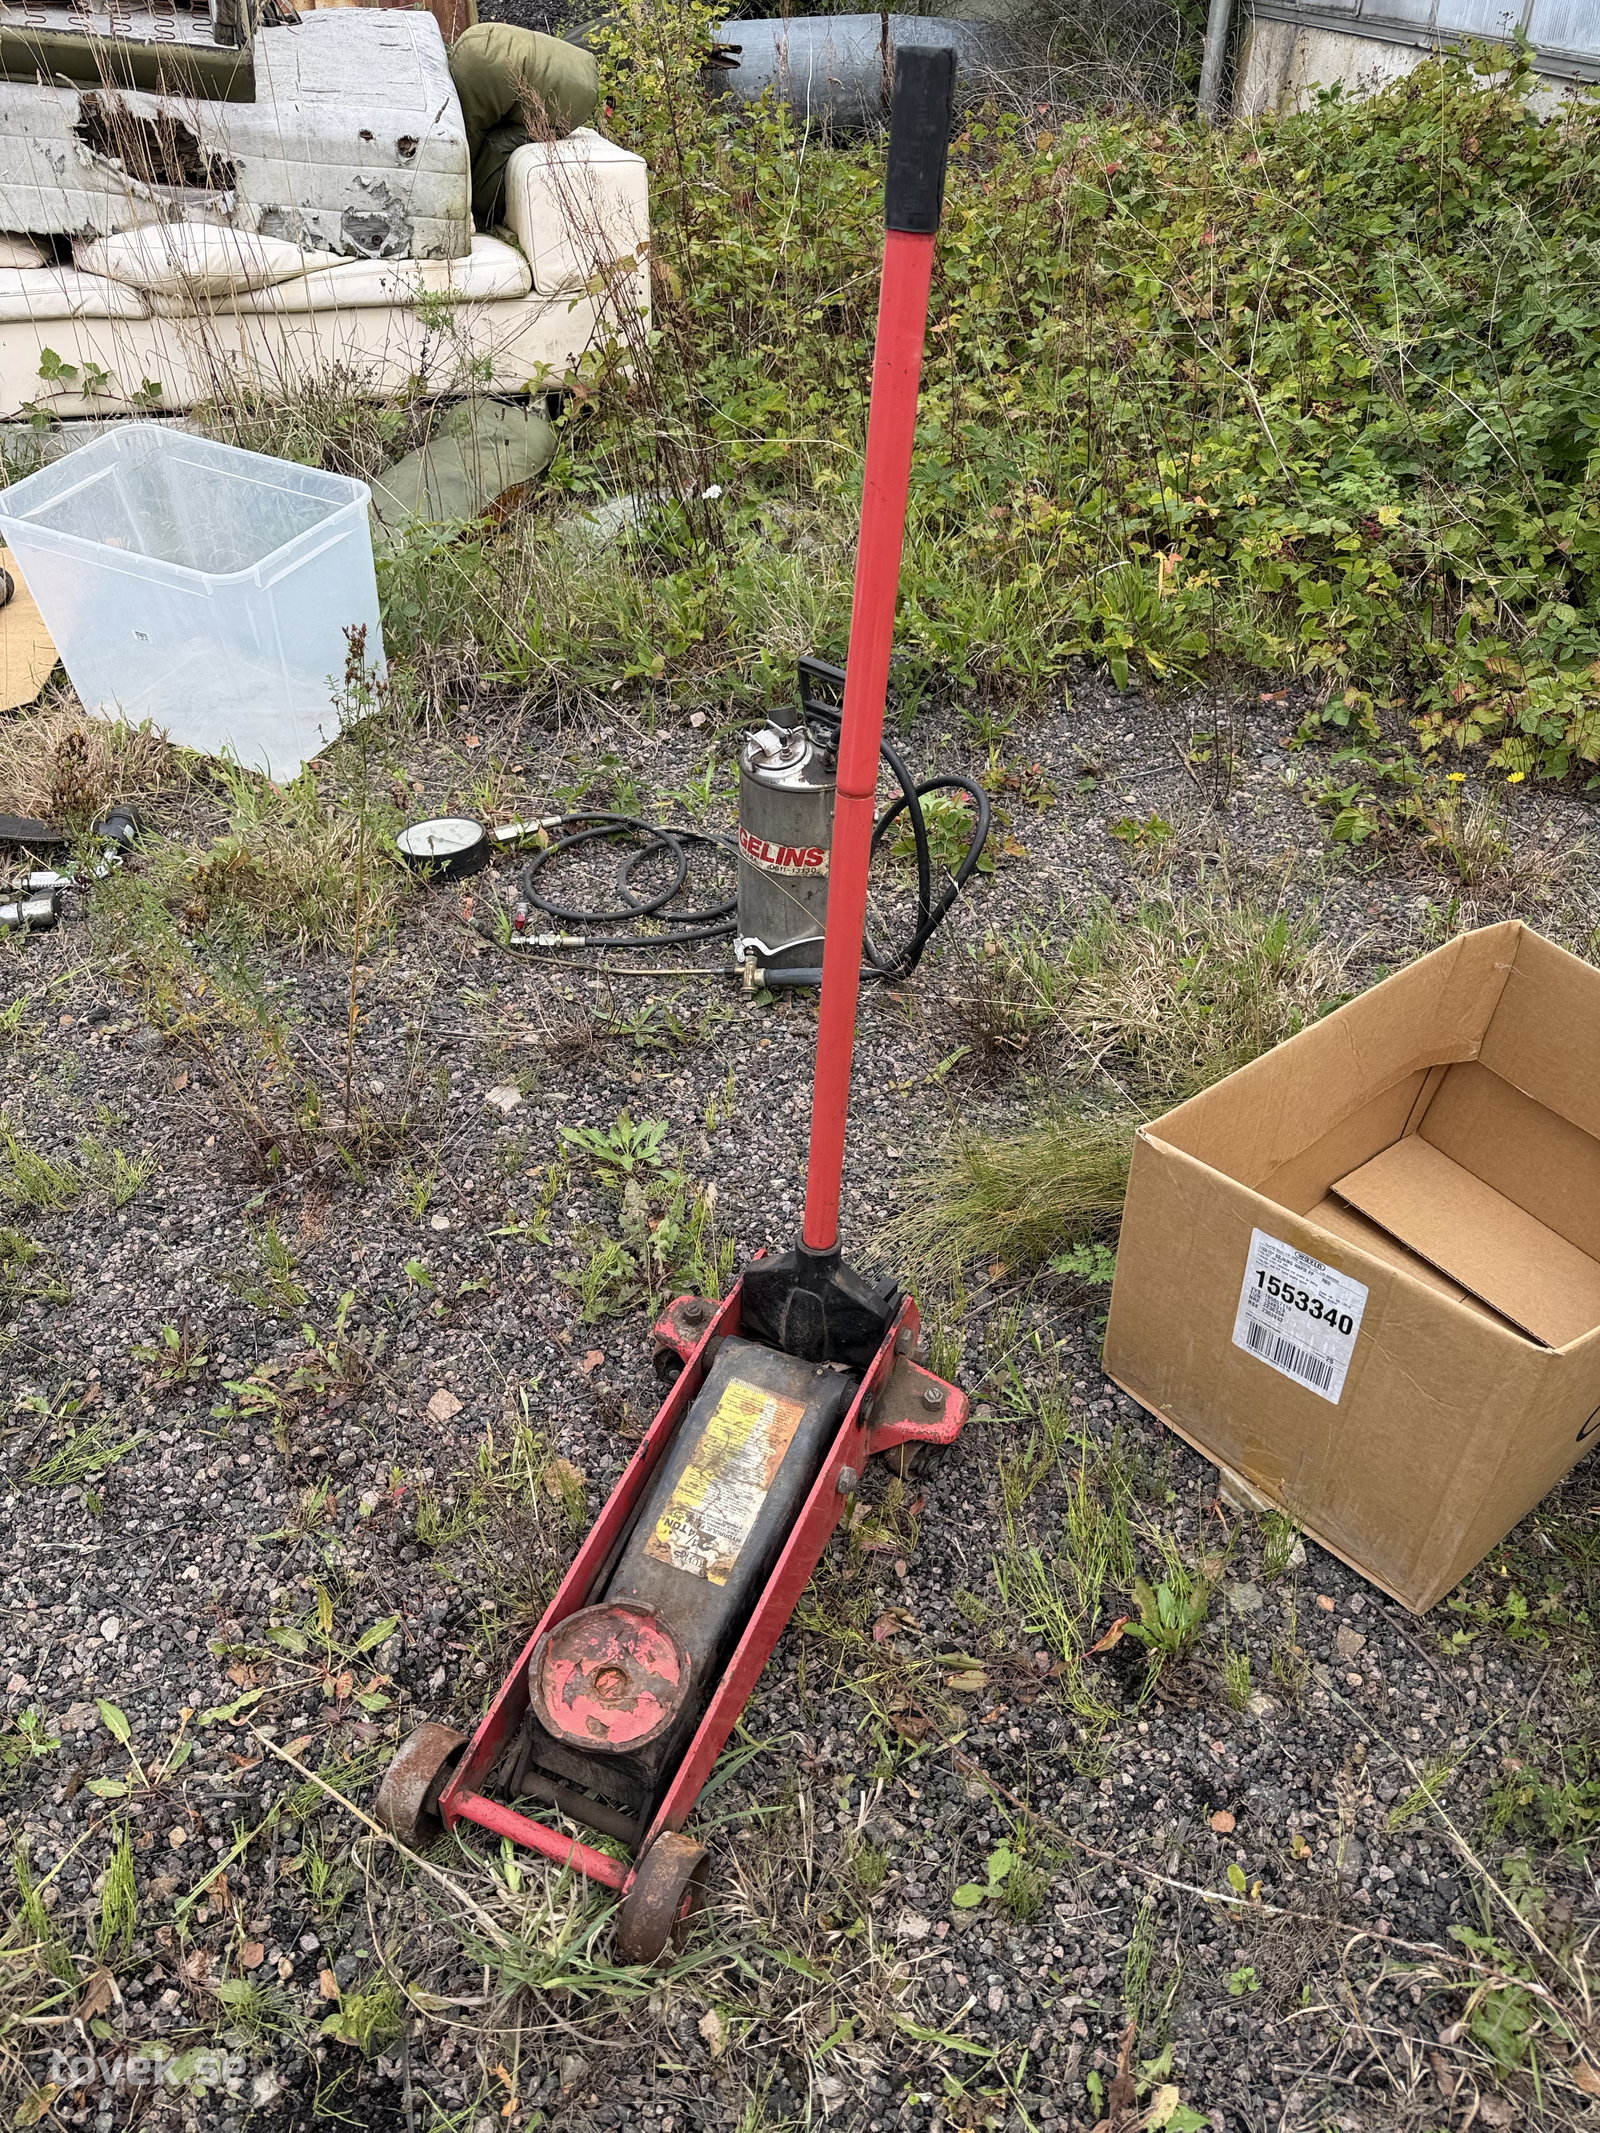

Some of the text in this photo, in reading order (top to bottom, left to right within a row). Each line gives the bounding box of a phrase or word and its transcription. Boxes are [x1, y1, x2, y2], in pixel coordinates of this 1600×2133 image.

[740, 827, 824, 867] GELINS
[1256, 1270, 1353, 1335] 1553340
[664, 1518, 687, 1533] TON
